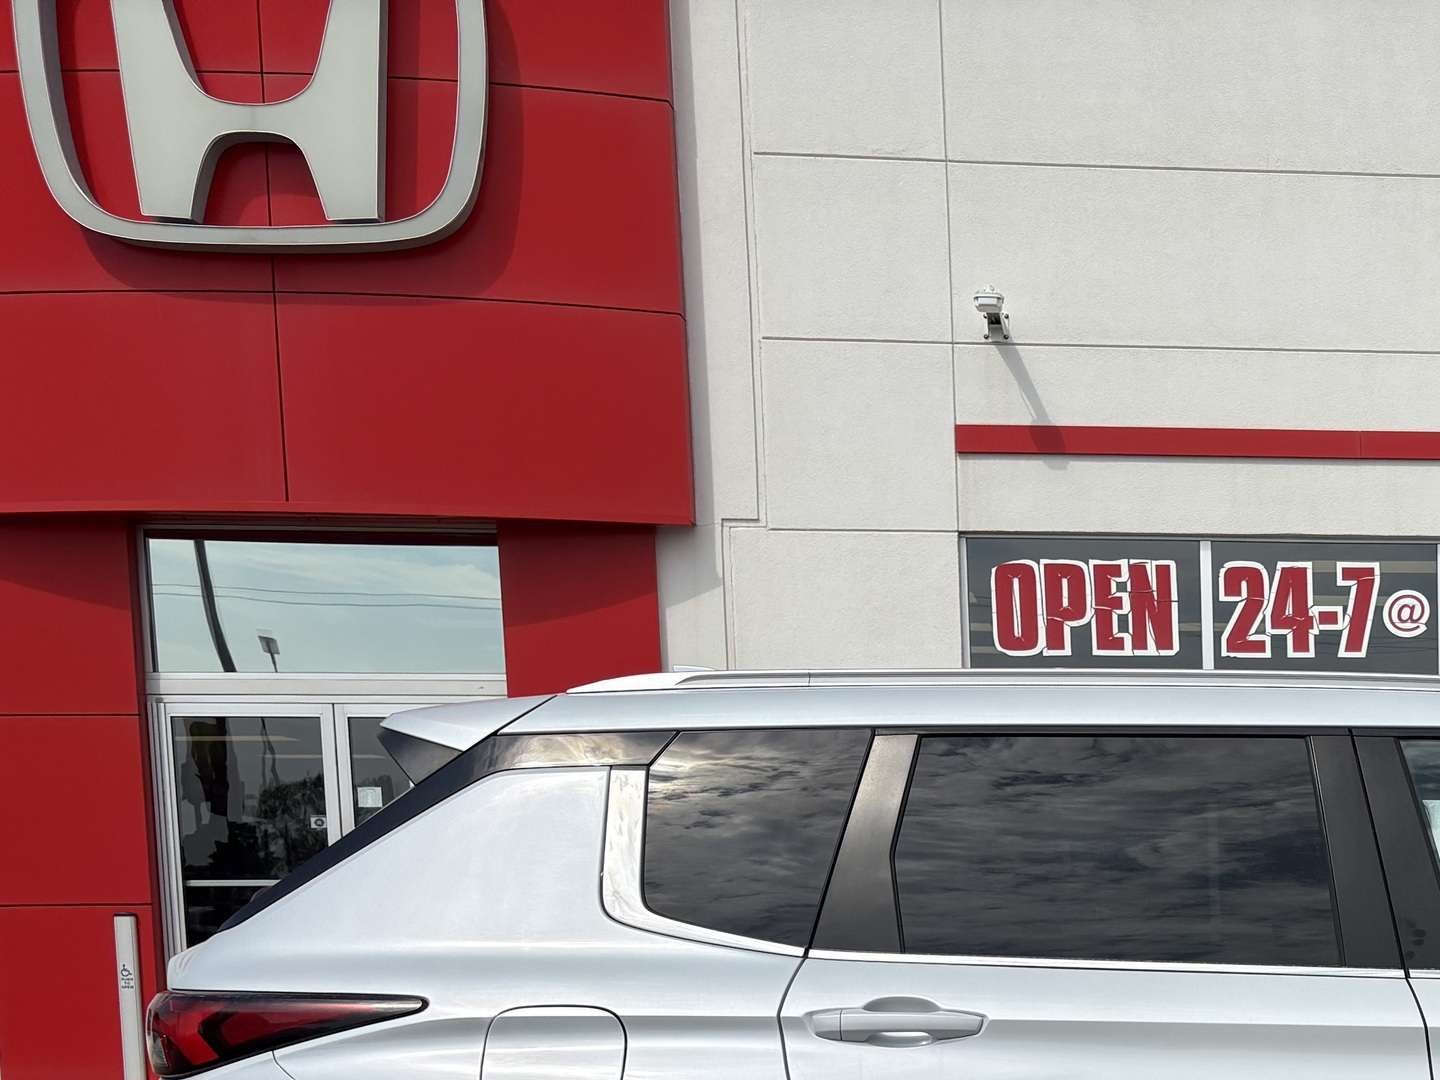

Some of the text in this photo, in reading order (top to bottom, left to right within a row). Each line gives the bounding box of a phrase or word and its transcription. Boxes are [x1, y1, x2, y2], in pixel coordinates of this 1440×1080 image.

[991, 559, 1180, 657] OPEN
[1217, 560, 1381, 659] 24-7
[1383, 589, 1431, 638] @
